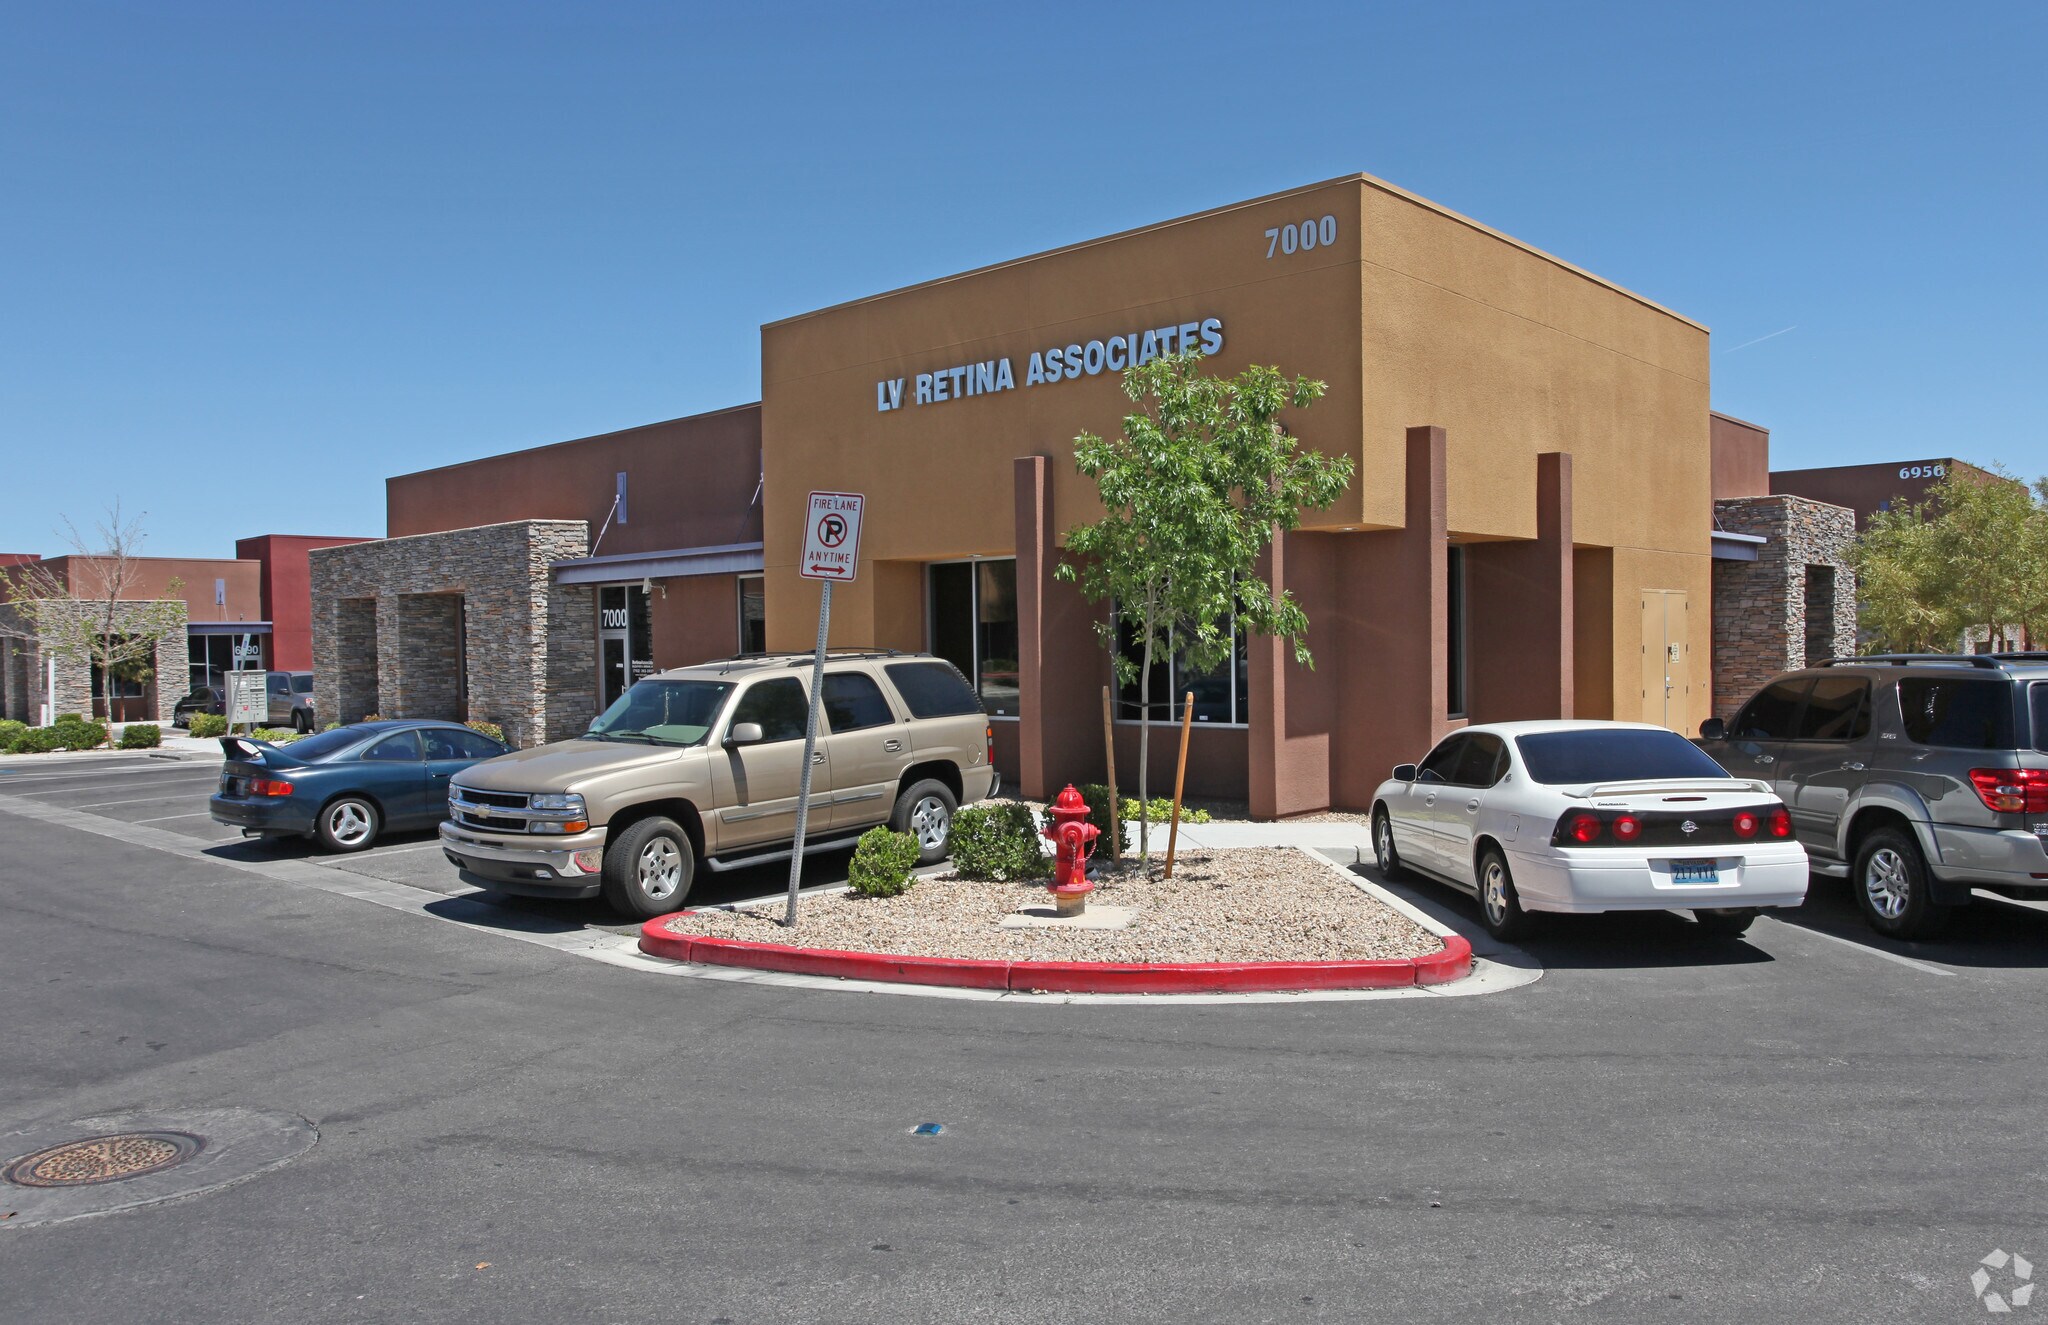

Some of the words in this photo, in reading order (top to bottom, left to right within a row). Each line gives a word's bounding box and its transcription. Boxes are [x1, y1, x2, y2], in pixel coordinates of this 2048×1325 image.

[1265, 215, 1336, 259] 7000
[877, 378, 904, 411] LV
[916, 357, 1014, 405] RETINA
[1026, 317, 1224, 387] ASSOCIATES
[814, 499, 831, 510] FIRE
[835, 500, 858, 511] LANE
[809, 551, 851, 564] ANYTIME
[602, 608, 627, 627] 7000
[235, 645, 259, 655] 690
